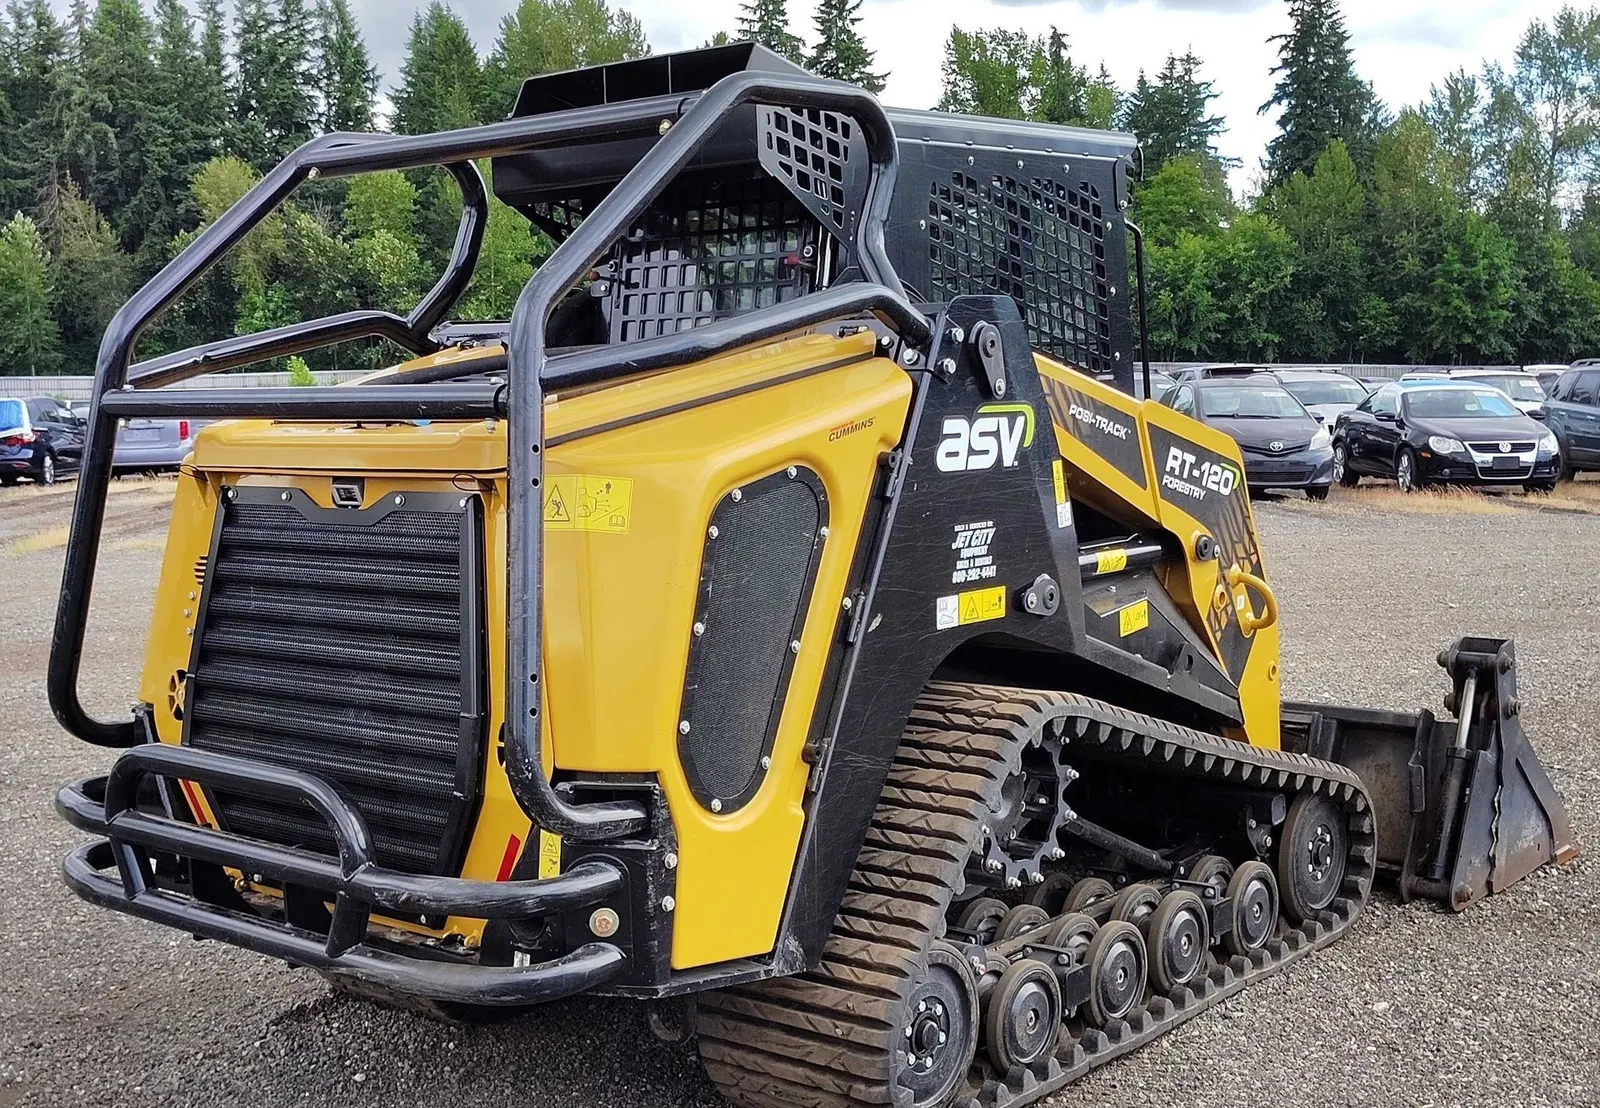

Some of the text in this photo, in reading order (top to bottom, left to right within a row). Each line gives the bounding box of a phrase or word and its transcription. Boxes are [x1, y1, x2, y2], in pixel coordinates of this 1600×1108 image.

[828, 417, 874, 442] CUMMINS
[1068, 403, 1128, 440] POSI-TRACK
[1165, 446, 1234, 496] RT-120
[1162, 475, 1206, 501] FORESTRY
[951, 527, 997, 550] JET CITY
